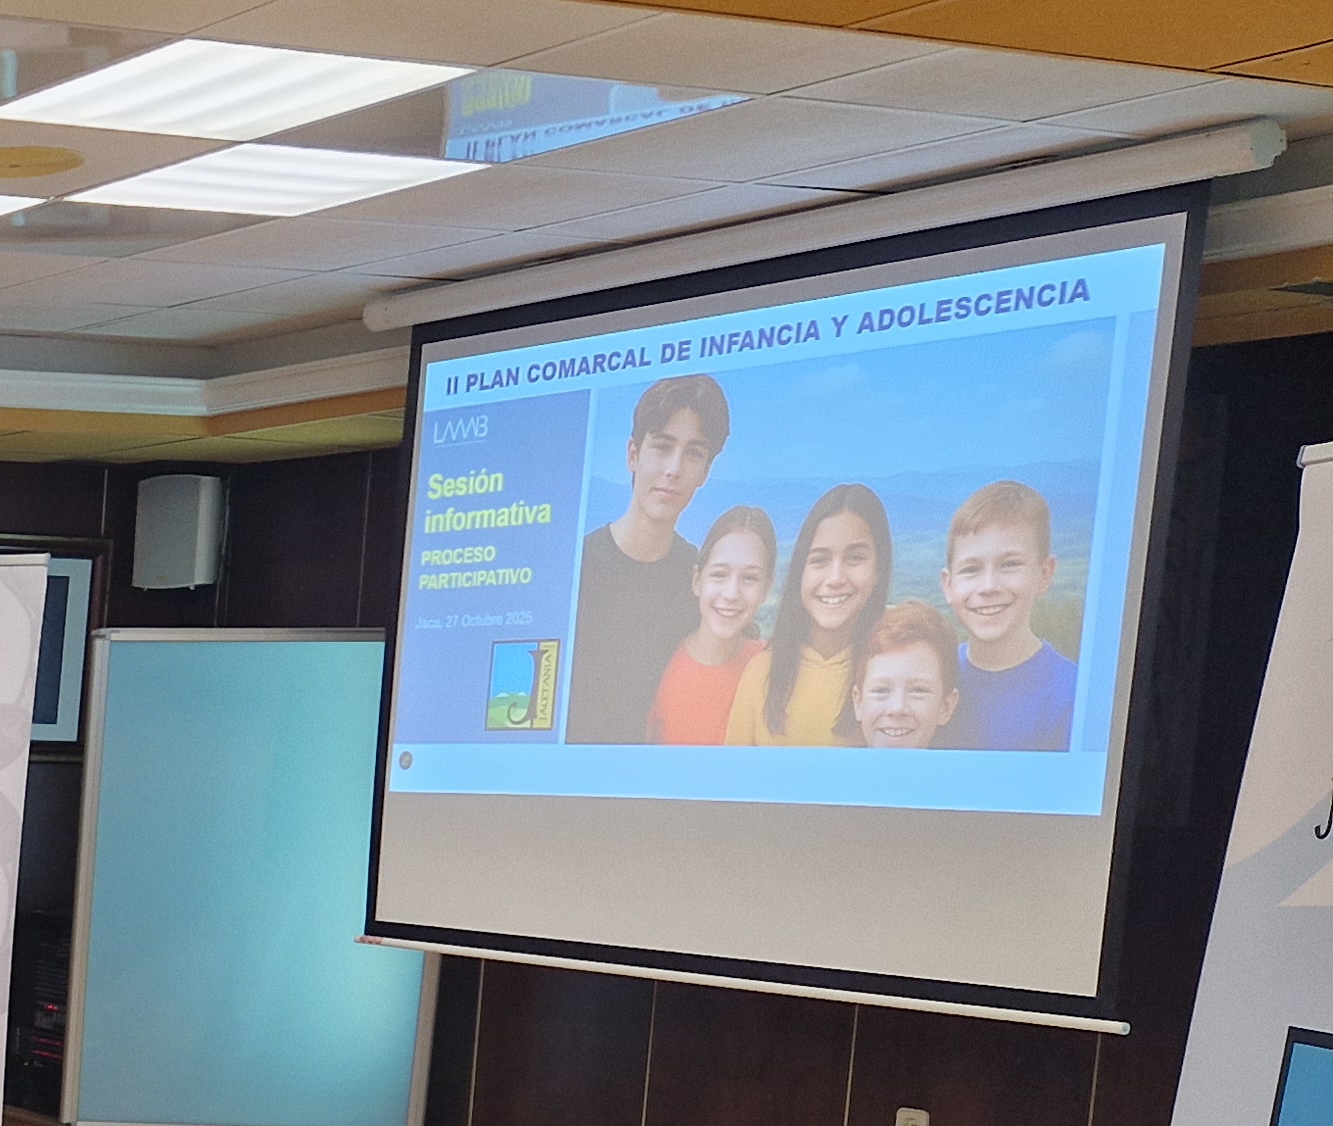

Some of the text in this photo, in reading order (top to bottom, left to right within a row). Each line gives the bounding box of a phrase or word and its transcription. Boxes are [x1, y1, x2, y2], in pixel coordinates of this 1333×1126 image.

[446, 278, 1091, 396] II PLAN COMARCAL DE INFANCIA Y ADOLESCENCIA
[427, 468, 504, 499] Sesión
[424, 500, 552, 534] informativa
[421, 546, 496, 566] PROCESO
[418, 567, 532, 590] PARTICIPATIVO
[445, 615, 459, 628] 27
[461, 613, 504, 628] Octubre
[505, 611, 534, 625] 2025
